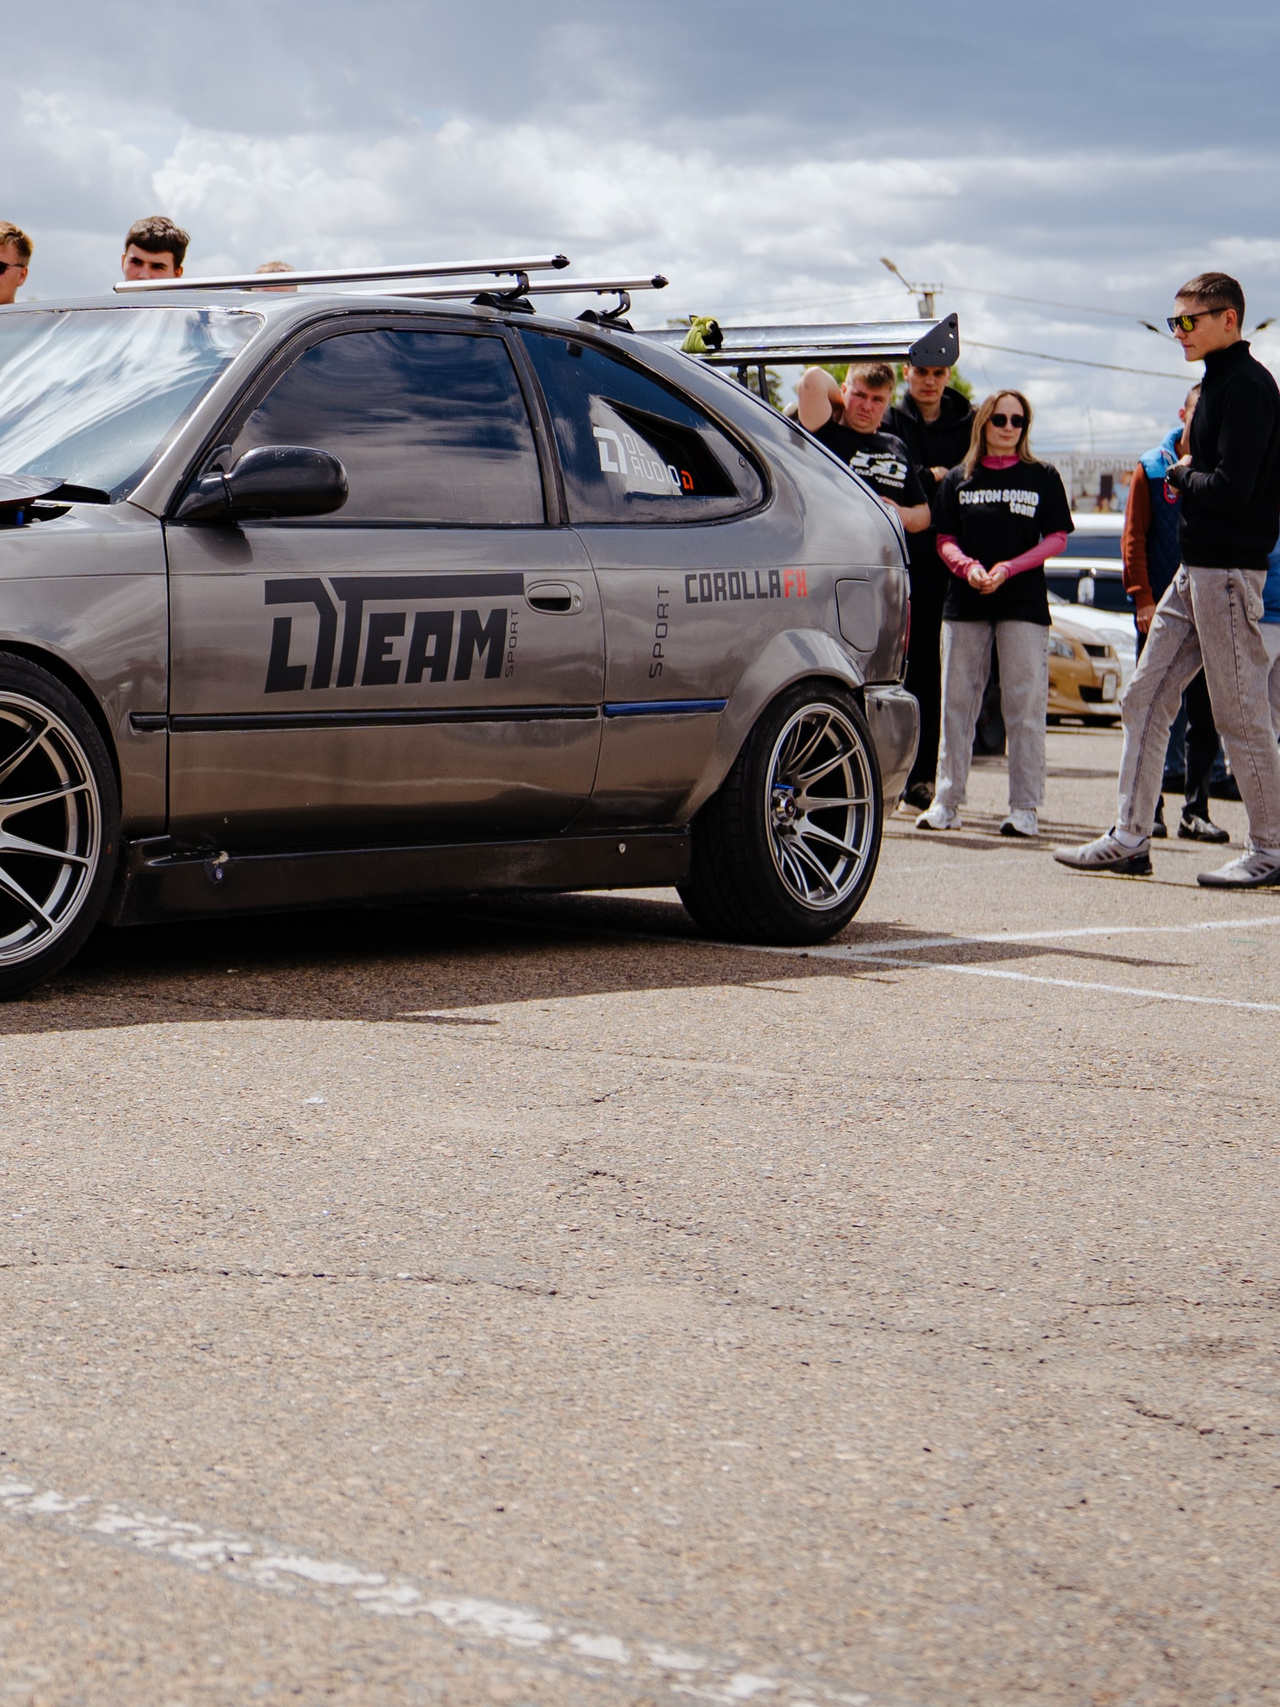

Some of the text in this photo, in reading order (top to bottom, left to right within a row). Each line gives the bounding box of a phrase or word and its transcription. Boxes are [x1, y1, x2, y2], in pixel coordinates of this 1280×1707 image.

[623, 433, 645, 457] DL
[630, 456, 681, 487] AUDIO
[959, 489, 1039, 506] CUSTOM SOUND
[1009, 501, 1036, 518] team
[505, 608, 520, 678] SPORT
[648, 585, 670, 679] SPORT
